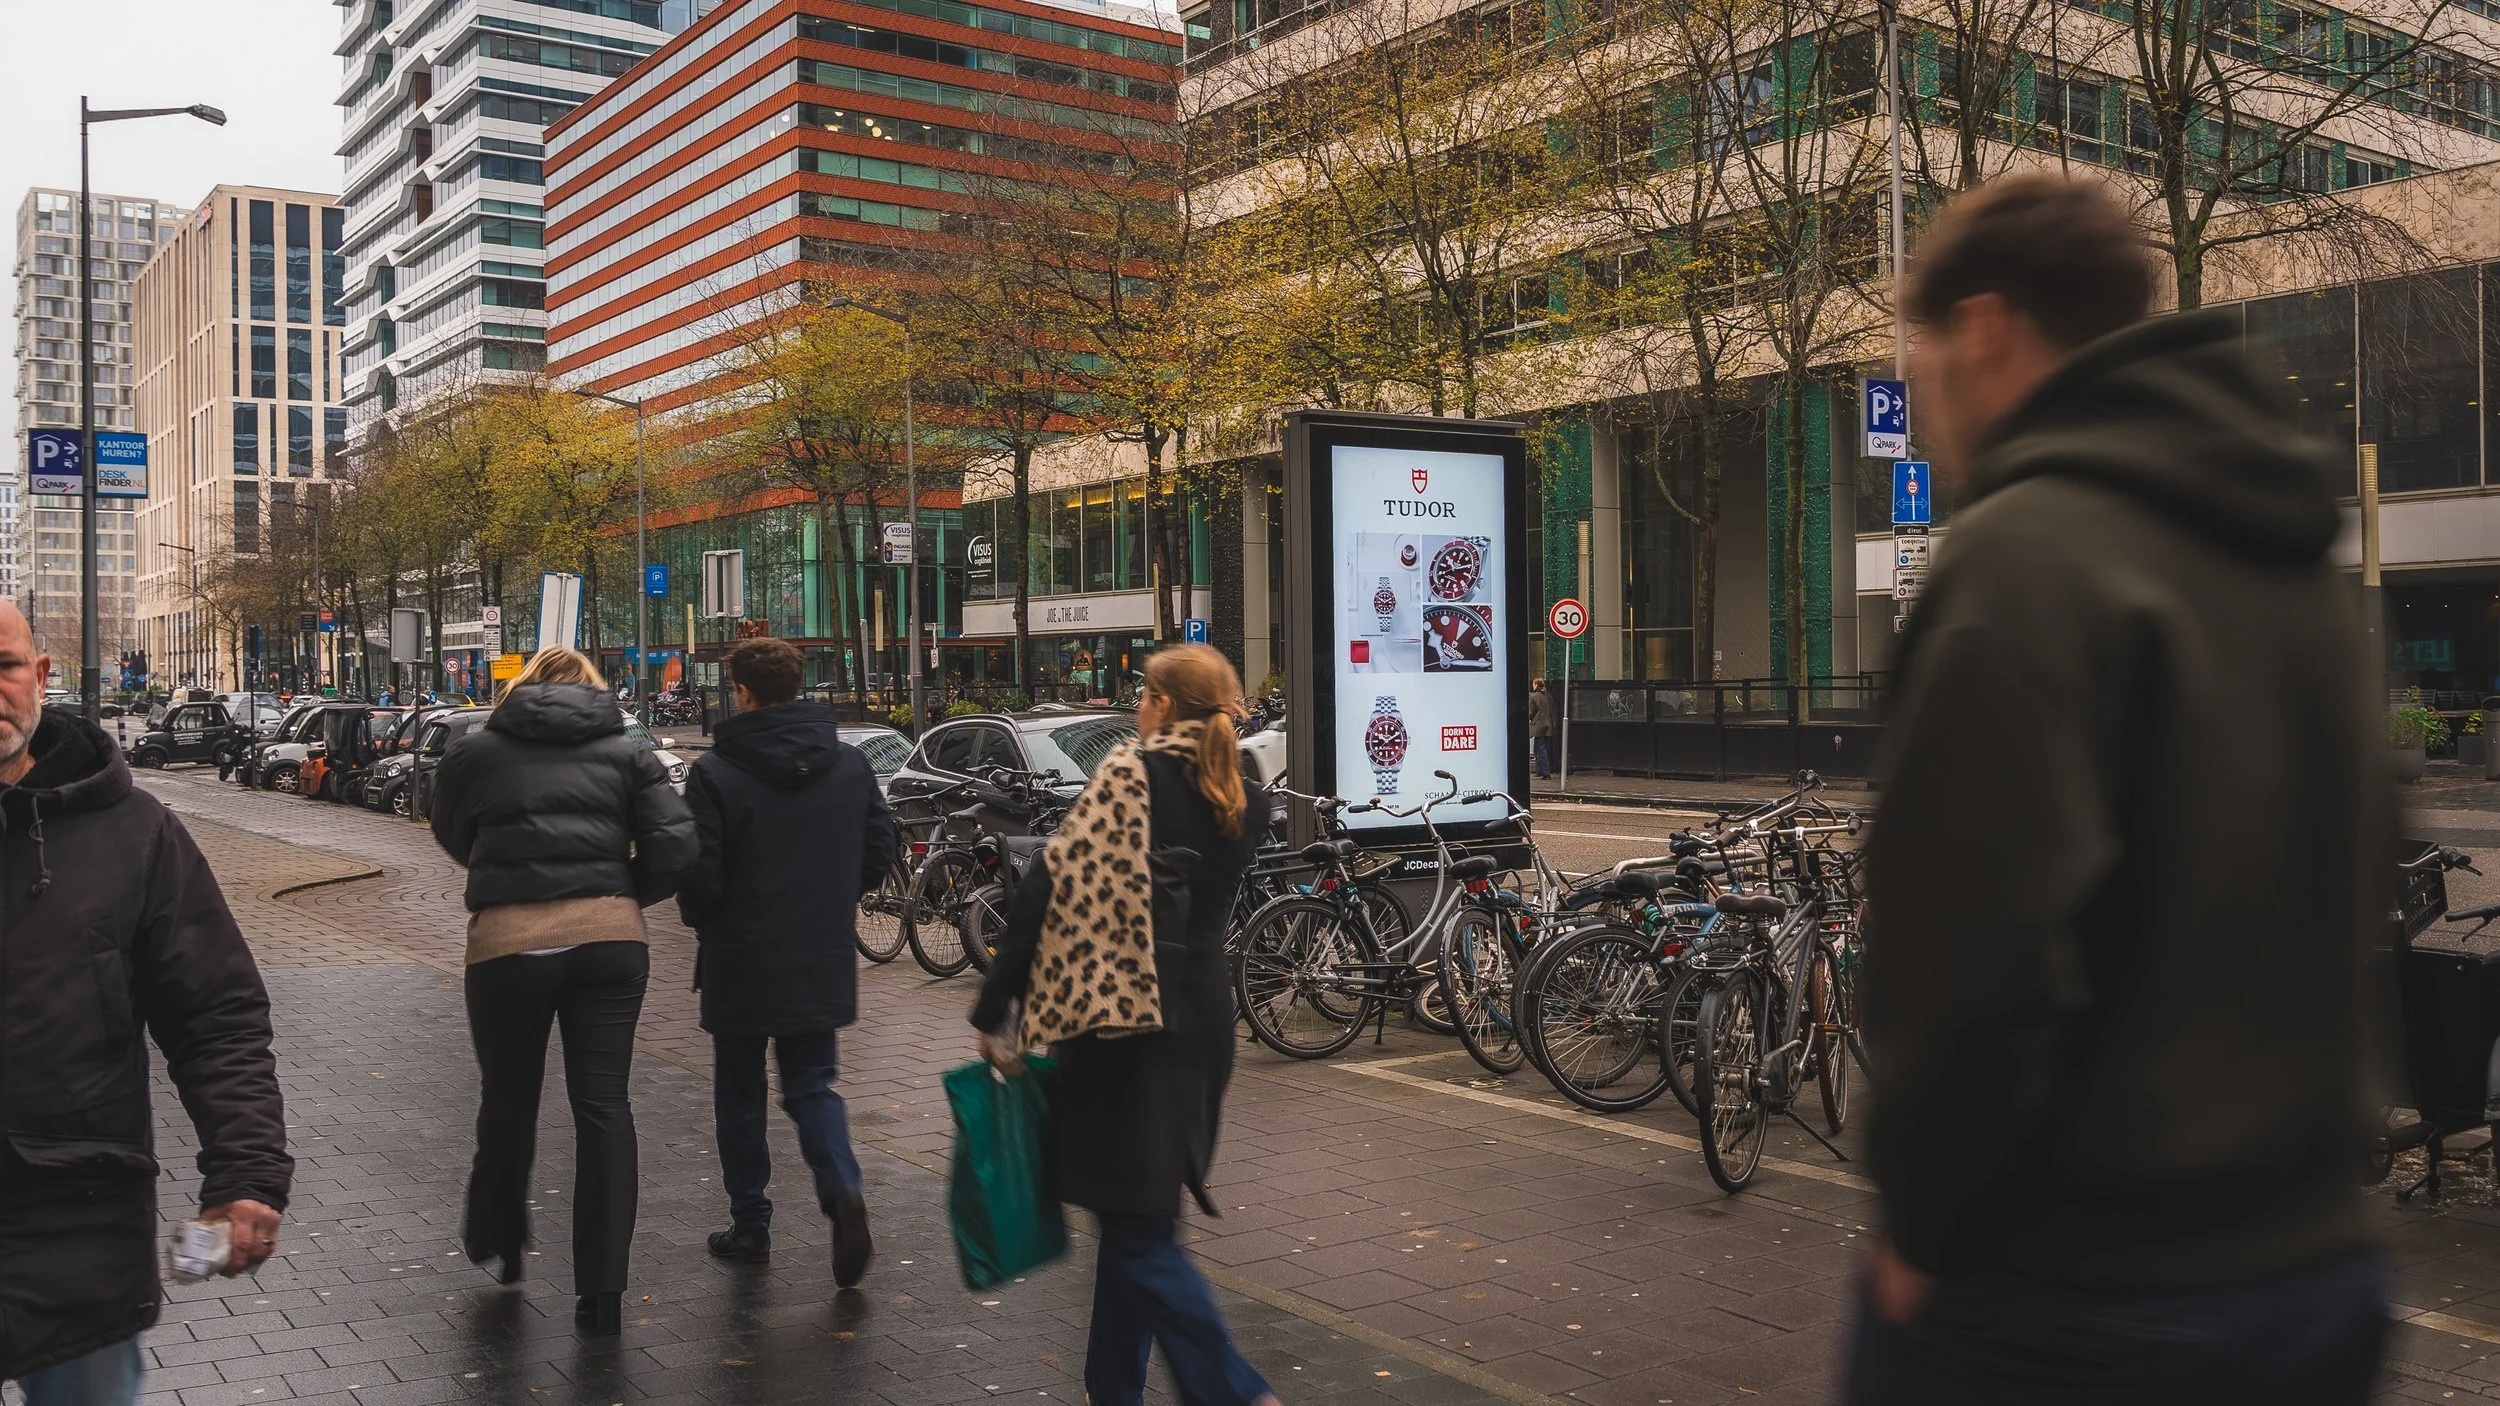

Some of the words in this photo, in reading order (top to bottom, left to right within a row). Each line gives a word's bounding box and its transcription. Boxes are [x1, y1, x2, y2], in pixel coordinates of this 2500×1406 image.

[1873, 393, 1890, 426] P
[98, 441, 145, 450] KANTOOR
[37, 440, 60, 468] P
[102, 450, 142, 458] HUREN?
[98, 470, 128, 479] DESK
[98, 479, 145, 487] FINDER.NL
[1383, 499, 1457, 518] TUDOR
[973, 543, 992, 556] VISUS
[1047, 608, 1057, 623] JOE
[1061, 607, 1072, 622] THE
[1073, 606, 1089, 622] JUICE
[1557, 611, 1581, 626] 30
[1190, 621, 1202, 637] P
[1443, 728, 1464, 736] BORN
[1465, 727, 1475, 736] TO
[1443, 736, 1475, 750] DARE
